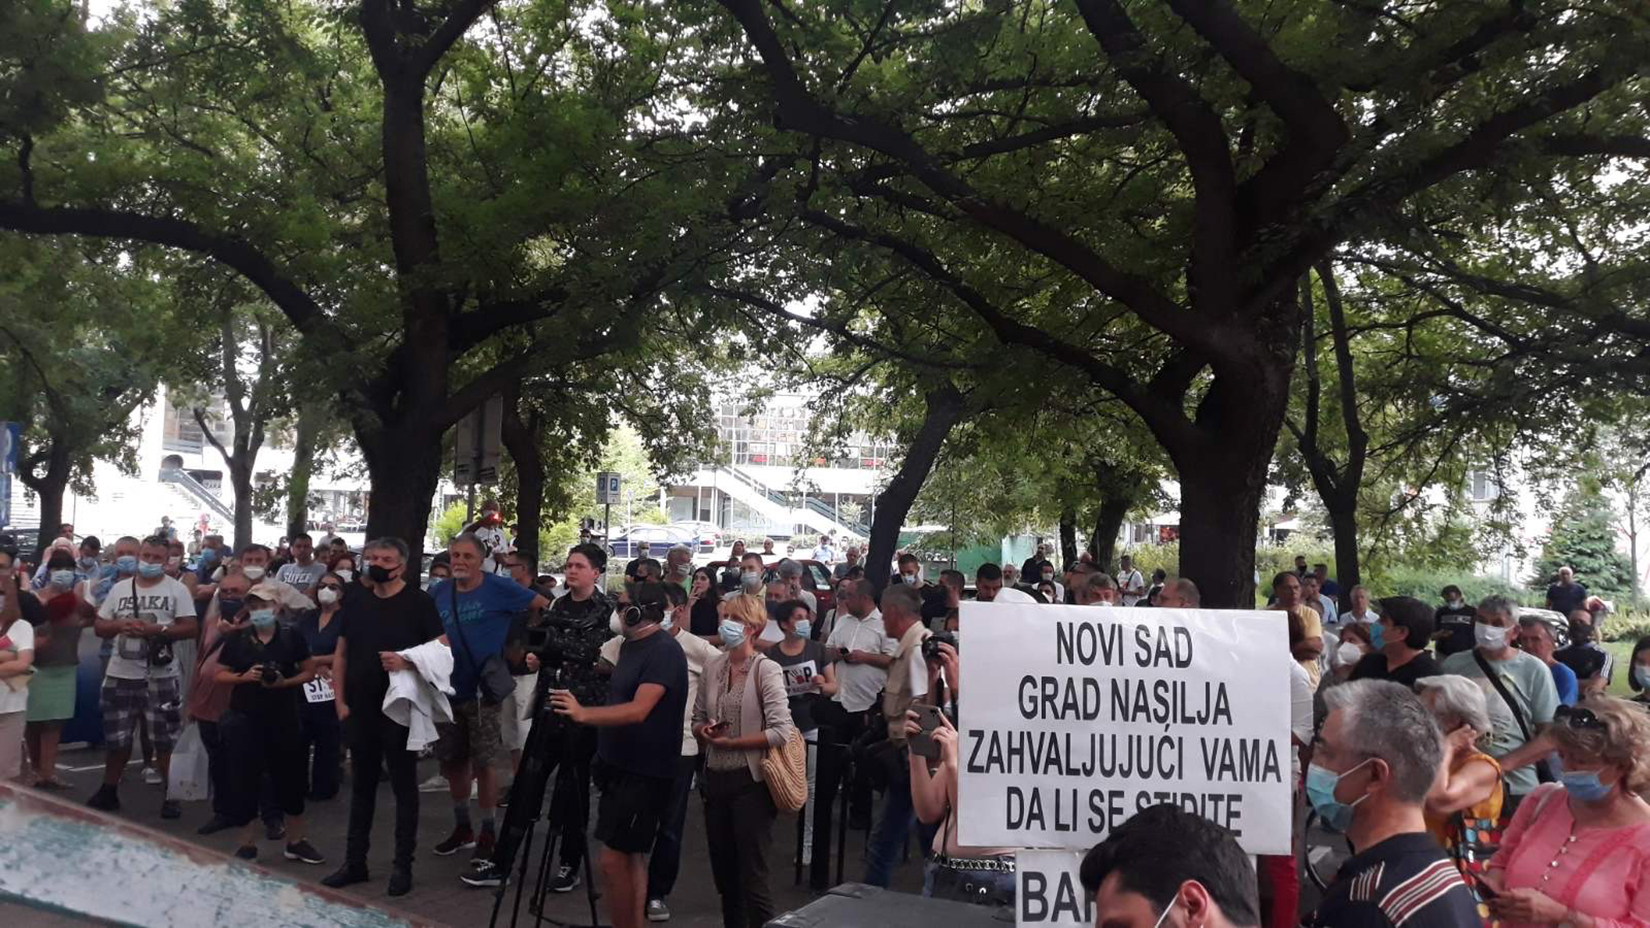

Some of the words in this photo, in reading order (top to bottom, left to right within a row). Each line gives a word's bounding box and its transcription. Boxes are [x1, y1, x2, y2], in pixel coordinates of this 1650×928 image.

[118, 595, 170, 611] OSAKA
[1056, 621, 1124, 666] NOVI
[1135, 624, 1193, 668] SAD
[1018, 675, 1101, 721] GRAD
[1111, 678, 1233, 726] NASILJA
[967, 724, 1183, 780] ZAHVALJUJUĆI
[1200, 737, 1282, 783] VAMA
[1006, 786, 1046, 831] DA
[1055, 788, 1077, 832] LI
[1088, 789, 1125, 833] SE
[1022, 871, 1092, 922] BA
